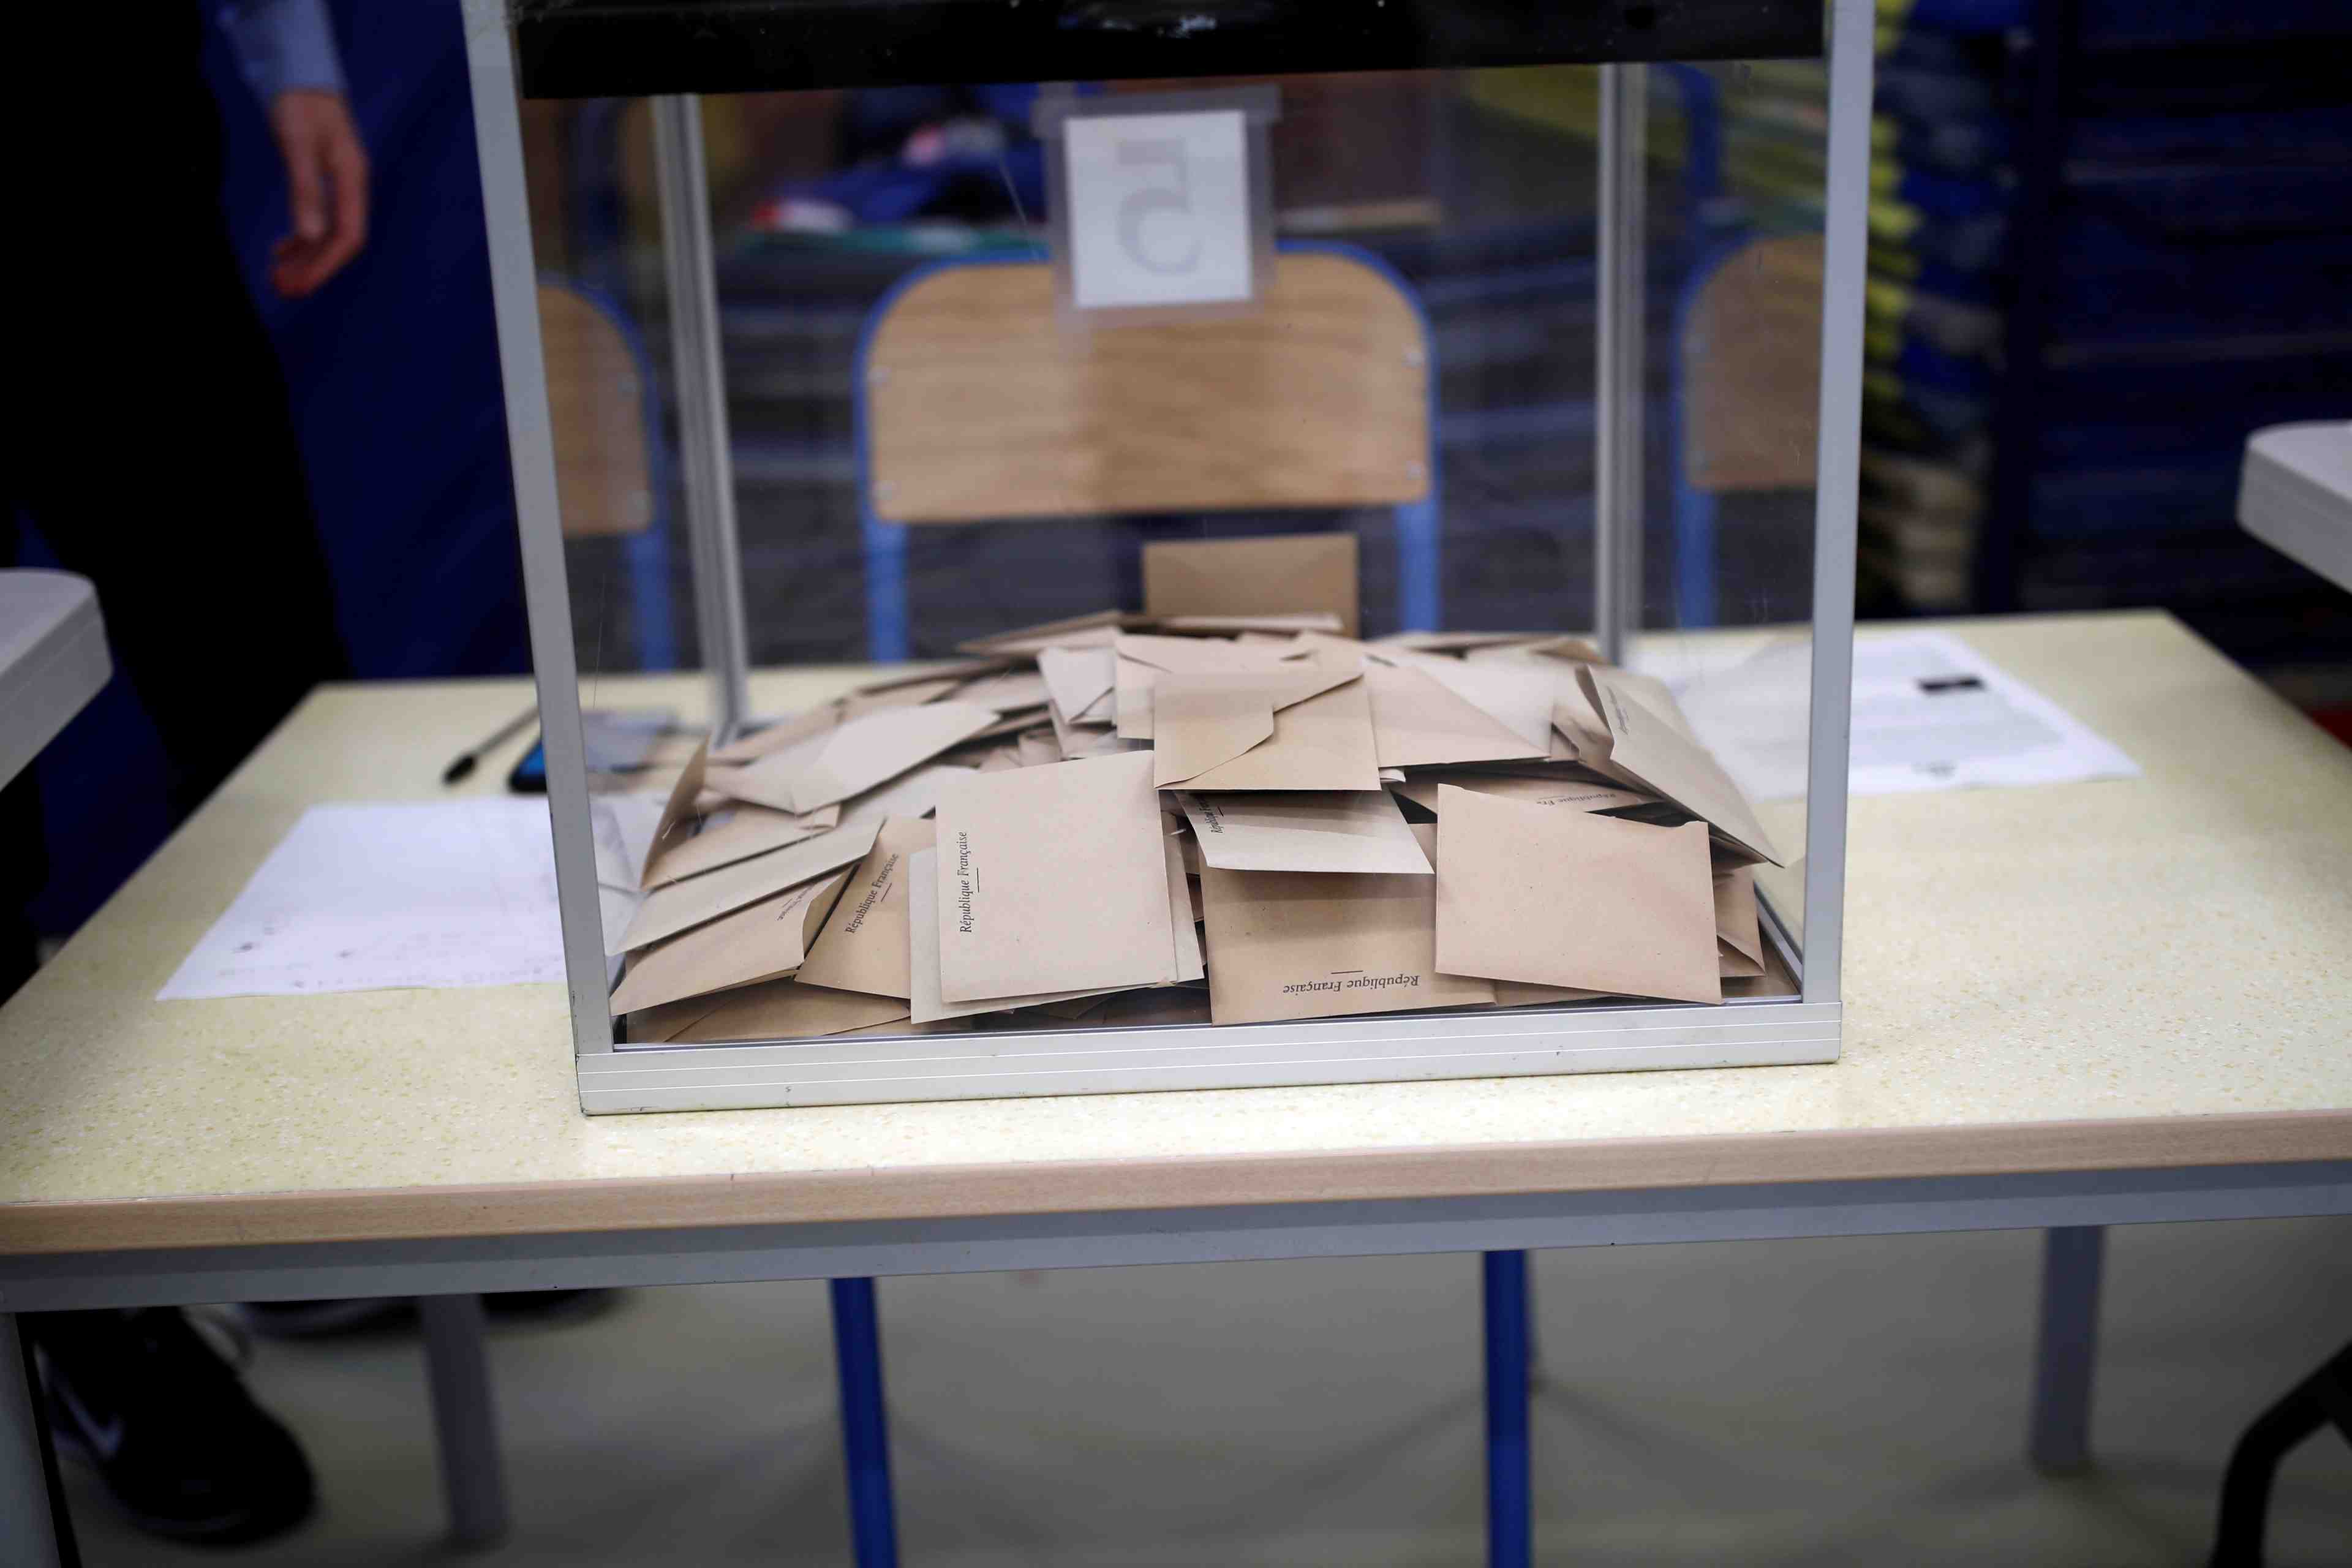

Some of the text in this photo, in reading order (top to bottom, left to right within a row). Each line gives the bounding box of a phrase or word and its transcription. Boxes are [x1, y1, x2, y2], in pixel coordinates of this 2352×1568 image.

[845, 853, 899, 933] République Française
[956, 832, 974, 933] République Française
[1283, 974, 1420, 995] République Française
